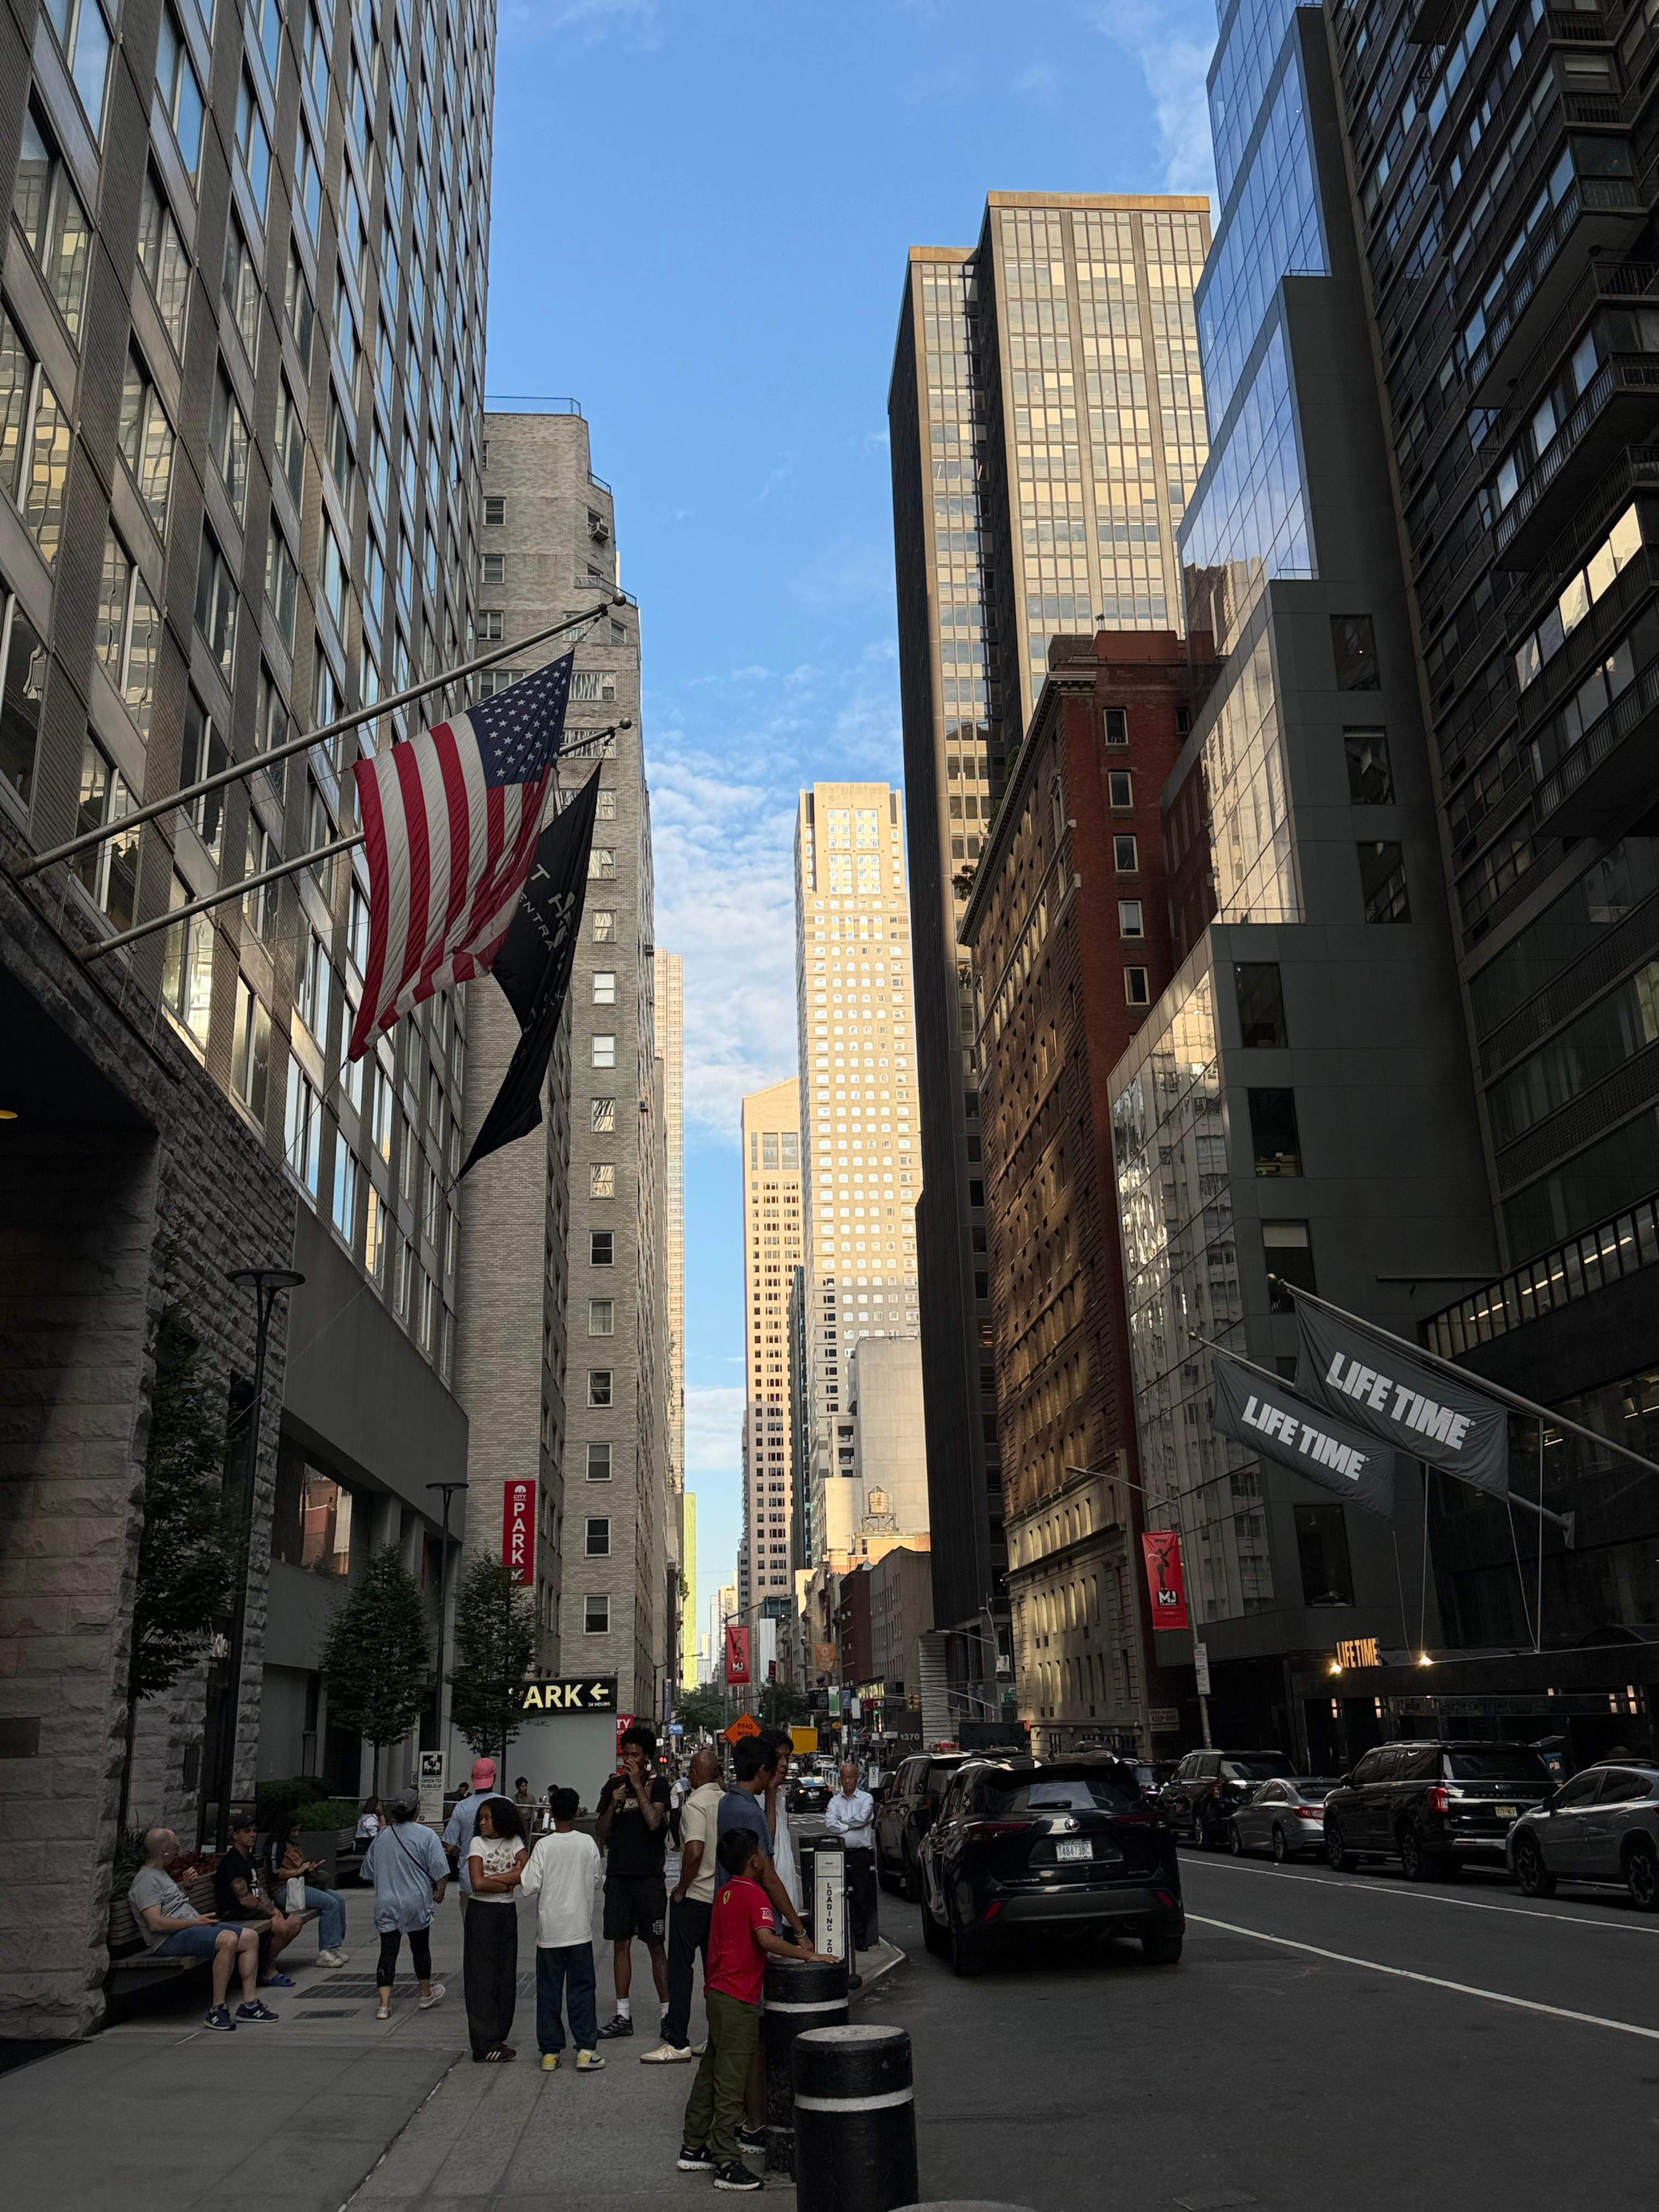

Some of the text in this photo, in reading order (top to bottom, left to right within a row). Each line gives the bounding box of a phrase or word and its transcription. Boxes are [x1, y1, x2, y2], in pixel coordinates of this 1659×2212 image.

[519, 892, 554, 952] ENTRA
[1325, 1351, 1471, 1451] LIFE TIME
[1241, 1395, 1367, 1481] LIFE TIME
[512, 1502, 526, 1564] PARK
[1158, 1590, 1177, 1603] MJ
[1336, 1638, 1379, 1668] LIFE TIME
[522, 1683, 584, 1709] ARK
[617, 1719, 630, 1729] TY
[900, 1733, 920, 1741] 1370
